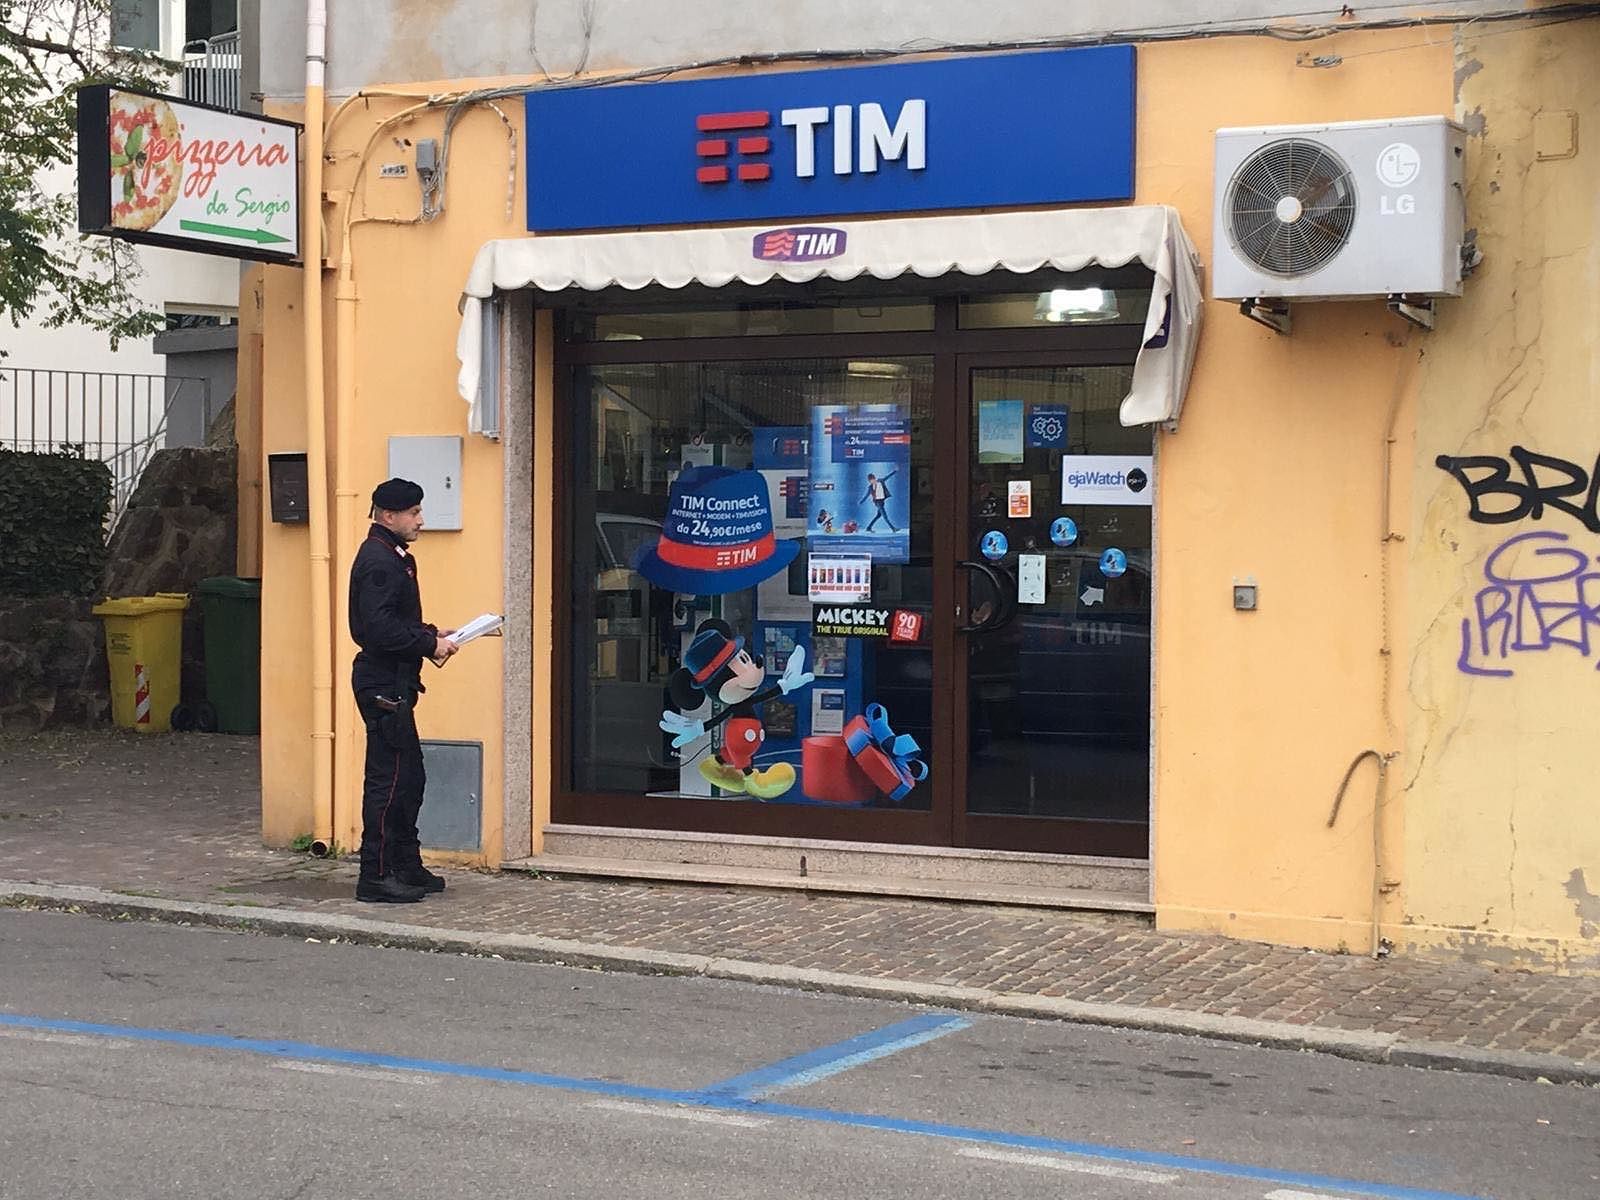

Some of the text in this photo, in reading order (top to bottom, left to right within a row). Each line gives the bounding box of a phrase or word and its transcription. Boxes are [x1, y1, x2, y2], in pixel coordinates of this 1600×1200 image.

[781, 99, 926, 177] TIM
[141, 123, 291, 198] pizzeria
[206, 187, 291, 224] da Sergio
[1380, 194, 1415, 215] LG
[796, 233, 838, 256] TIM
[1068, 471, 1126, 488] ejaWatch
[681, 494, 761, 511] TIM Connect
[671, 508, 702, 519] INTERNET
[706, 512, 731, 520] MODEM
[676, 522, 690, 534] da
[732, 546, 757, 565] TIM
[816, 608, 889, 626] MICKEY
[898, 613, 917, 629] 90
[816, 625, 889, 636] THE TRUE ORIGINAL
